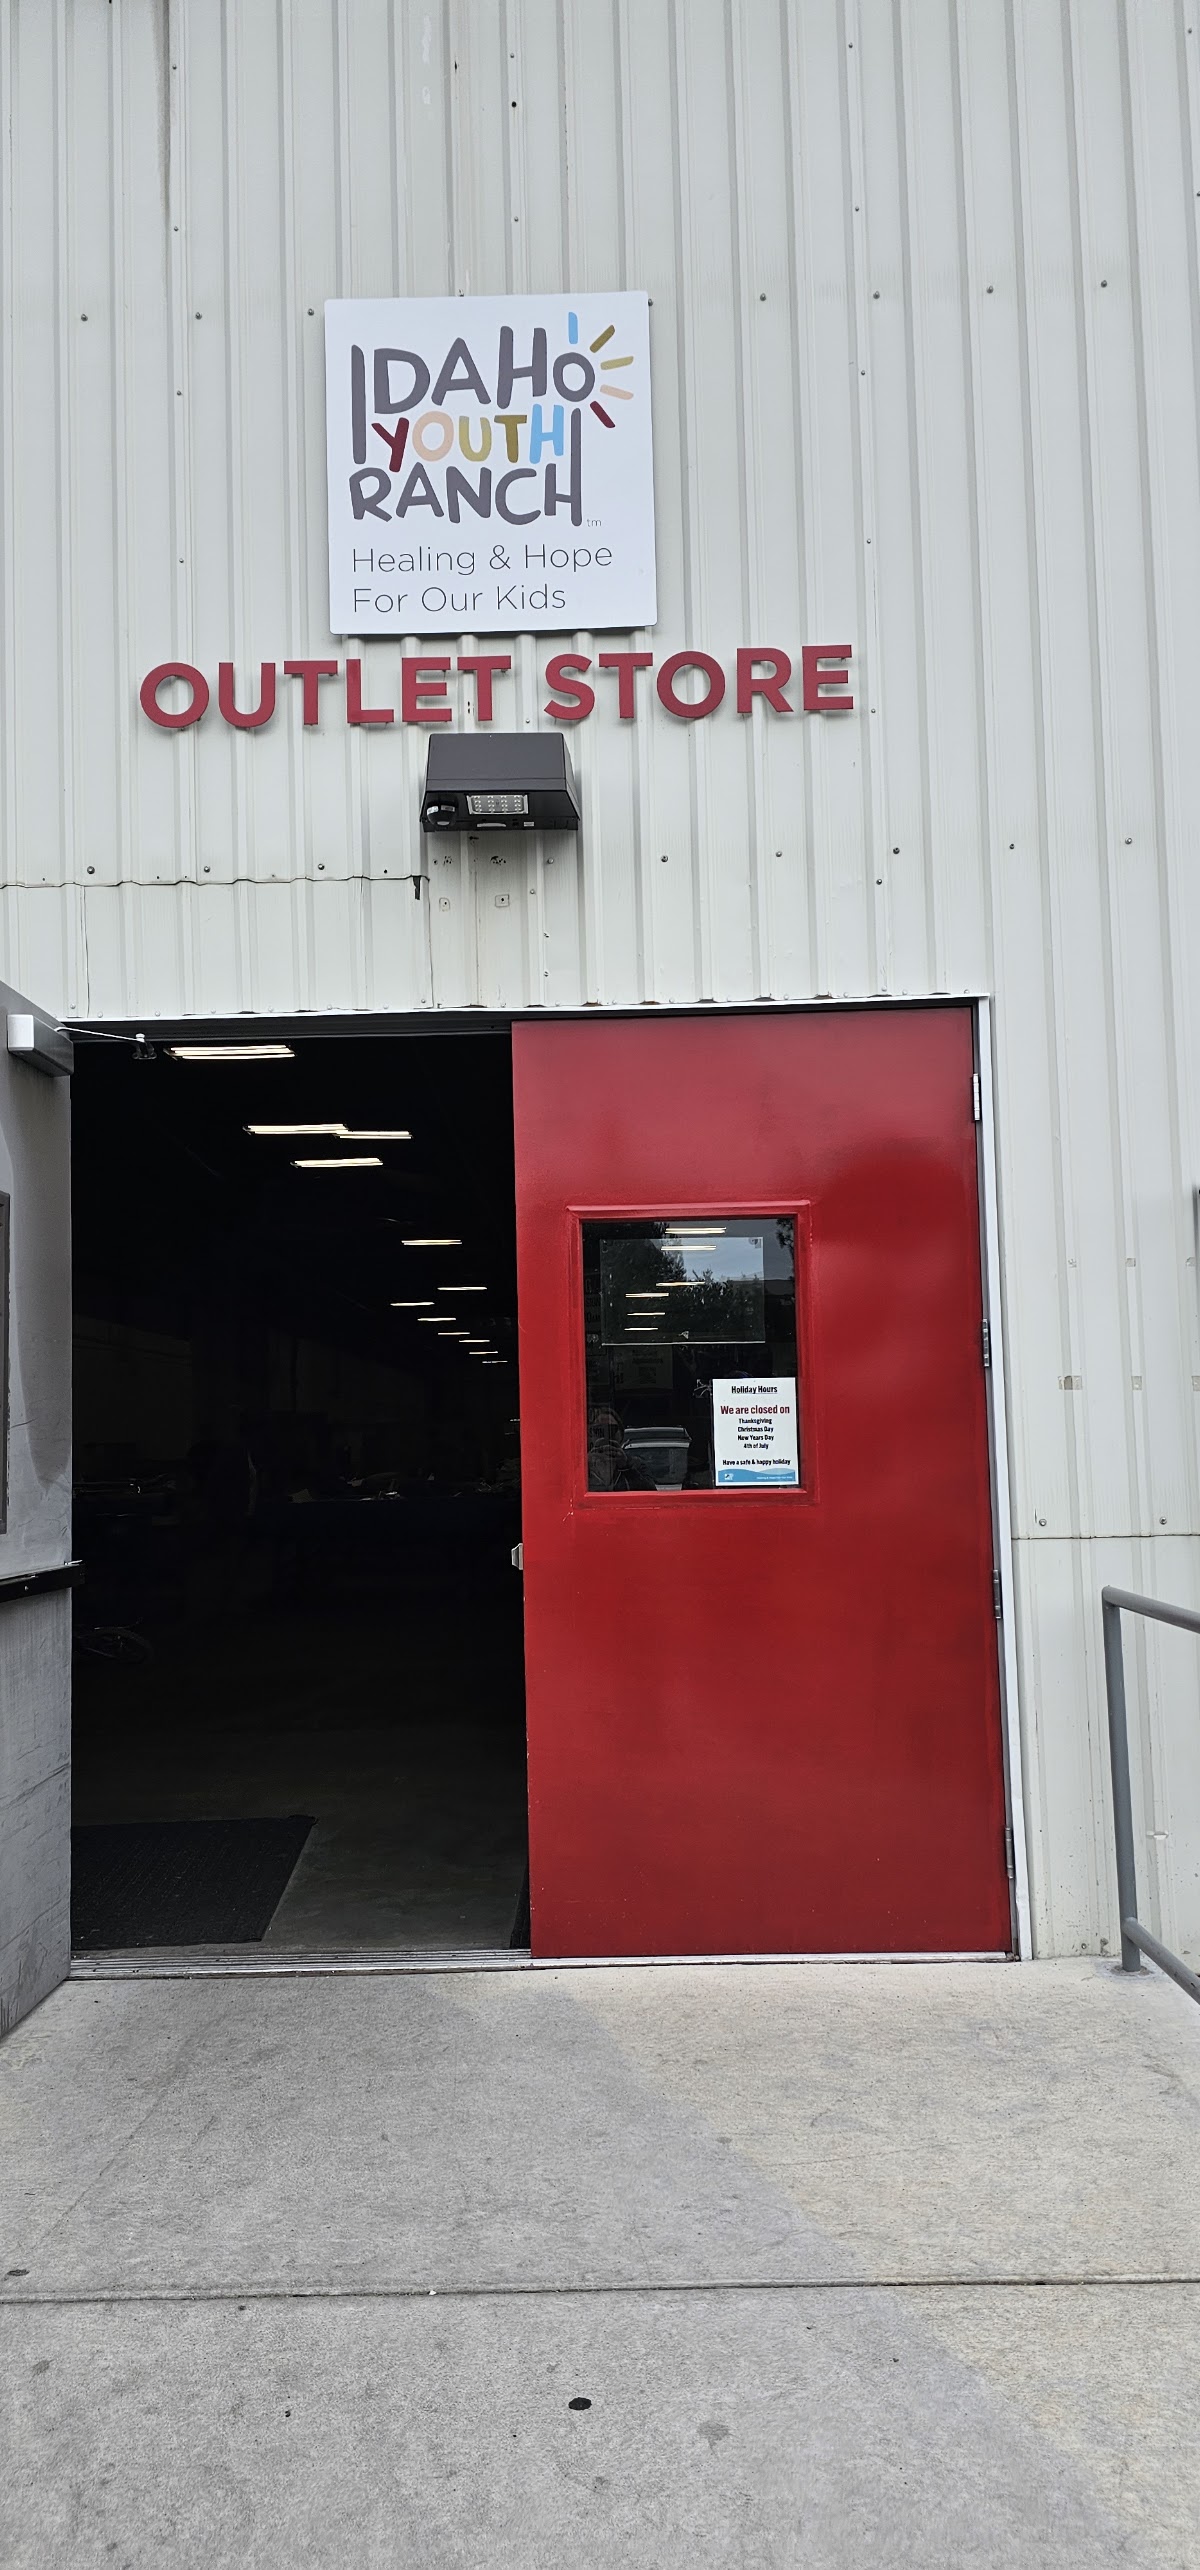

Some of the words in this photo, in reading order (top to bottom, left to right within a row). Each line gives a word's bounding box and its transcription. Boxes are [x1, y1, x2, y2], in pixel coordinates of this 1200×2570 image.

[351, 325, 595, 465] IDAHO
[371, 403, 565, 473] YOUTH
[348, 407, 583, 527] RANCH
[353, 546, 475, 576] Healing
[489, 544, 511, 570] &
[525, 543, 613, 574] Hope
[353, 588, 408, 613] For
[421, 586, 483, 612] Our
[496, 584, 566, 610] Kids
[139, 655, 512, 728] OUTLET
[543, 644, 855, 721] STORE
[720, 1406, 733, 1414] We
[750, 1405, 778, 1414] closed
[779, 1406, 790, 1414] on
[731, 1386, 757, 1394] Holiday
